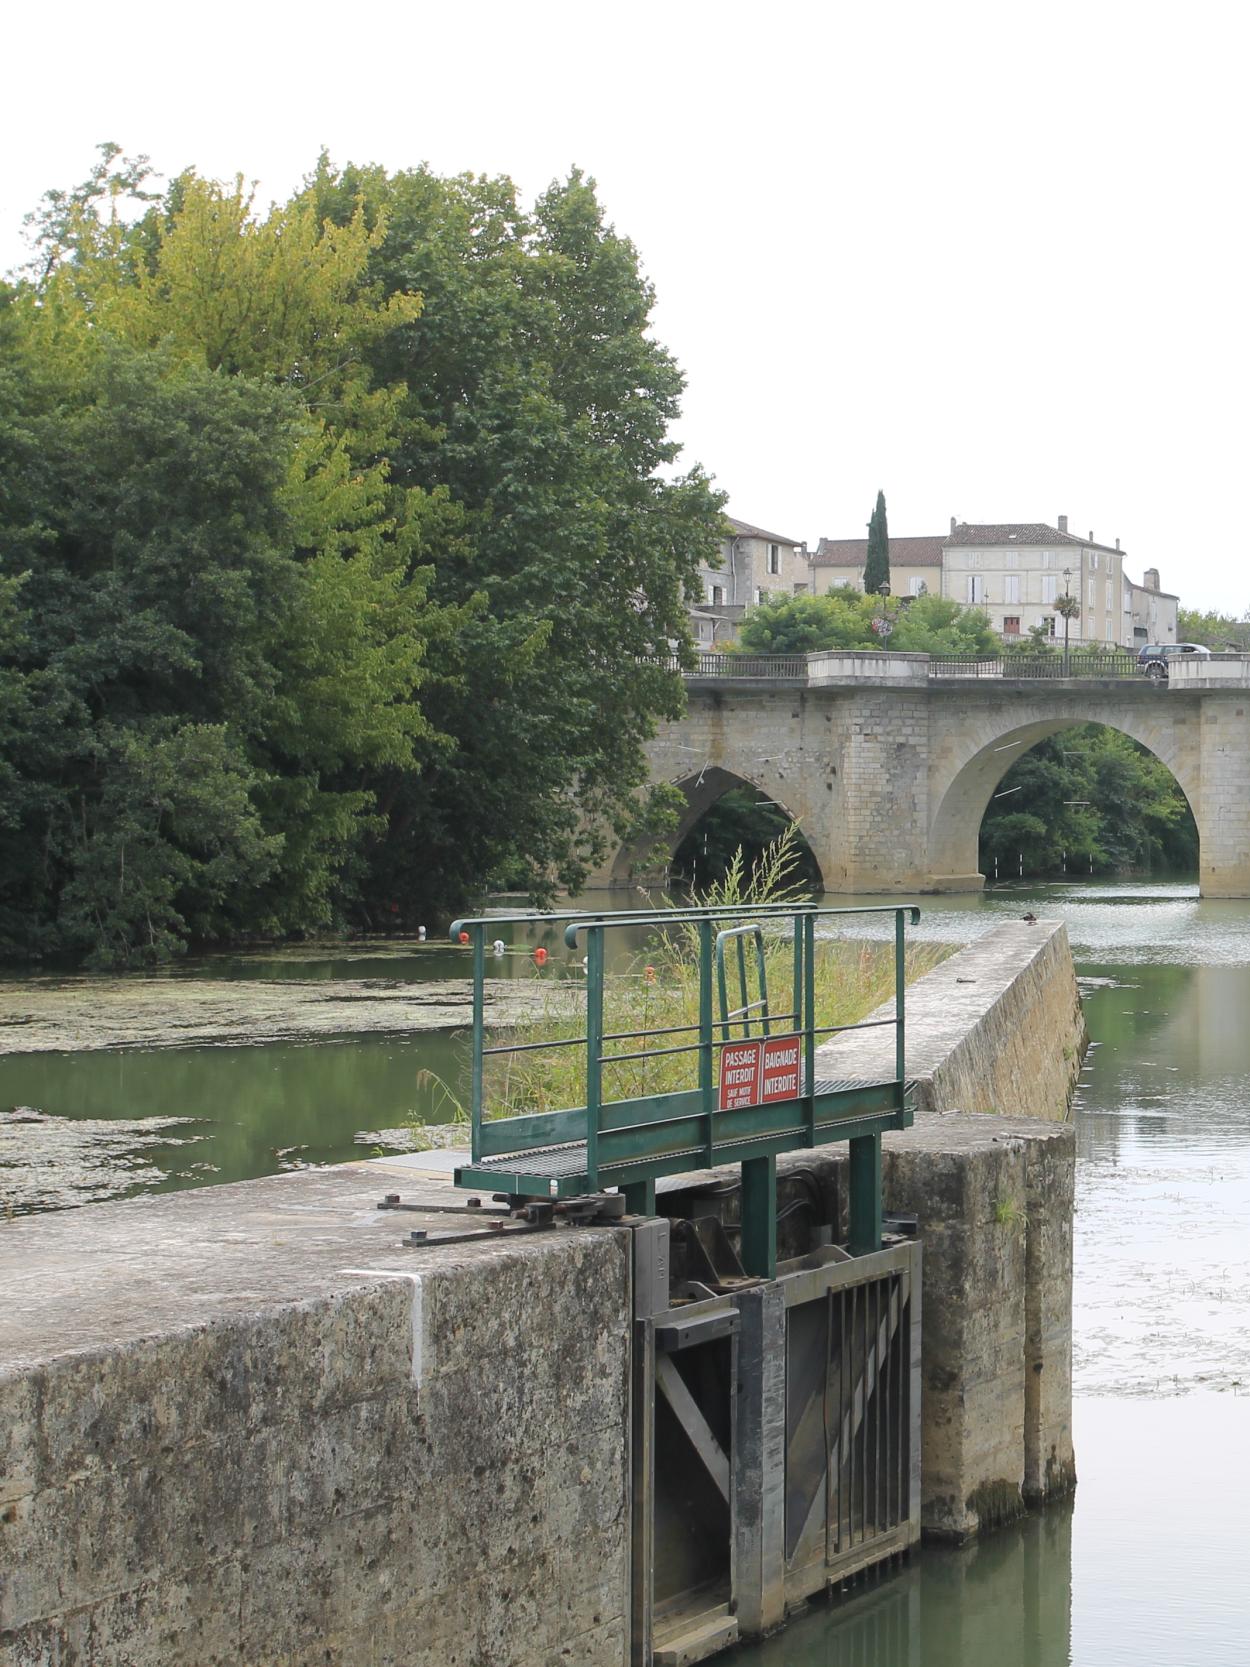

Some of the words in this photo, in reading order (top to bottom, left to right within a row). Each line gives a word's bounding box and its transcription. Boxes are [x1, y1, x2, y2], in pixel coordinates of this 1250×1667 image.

[725, 1049, 756, 1067] PASSAGE
[765, 1048, 797, 1069] BAIGNADE
[725, 1067, 755, 1085] INTERDIT
[764, 1073, 797, 1095] INTERDITE
[727, 1088, 738, 1098] SAUF
[739, 1086, 752, 1096] MOTIF
[727, 1099, 733, 1108] DE
[734, 1096, 751, 1107] SERVICE
